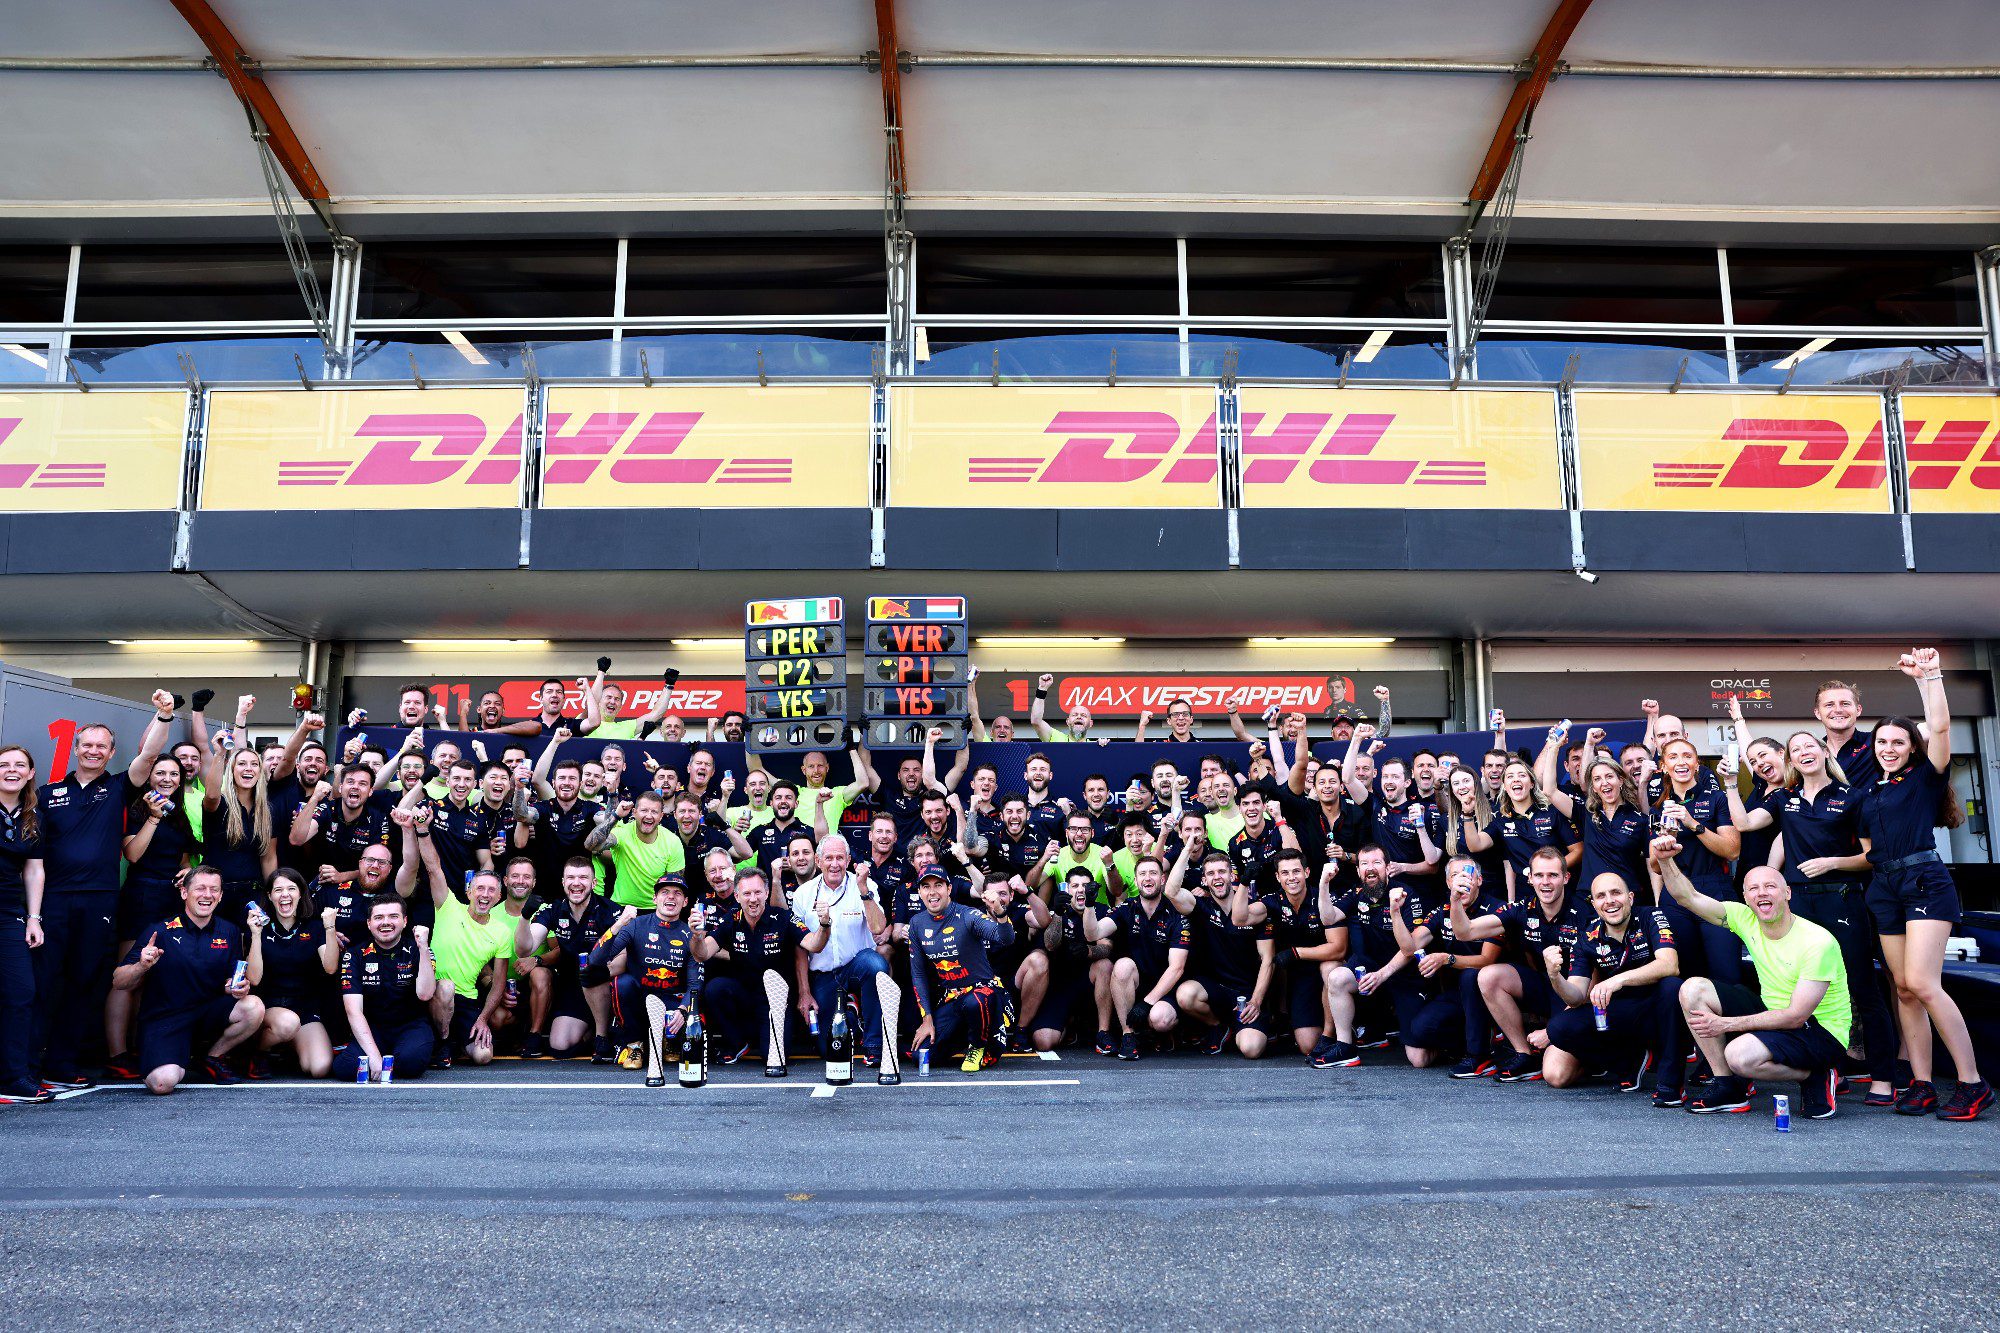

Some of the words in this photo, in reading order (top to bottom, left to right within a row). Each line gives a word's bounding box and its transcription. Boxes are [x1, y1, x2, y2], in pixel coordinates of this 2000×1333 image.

[344, 412, 724, 485] DHL
[1037, 411, 1420, 485] DHL
[1718, 418, 2000, 490] DH
[772, 627, 819, 655] PER
[891, 625, 943, 652] VER
[1005, 679, 1029, 712] 1
[1065, 686, 1138, 706] MAX
[1142, 686, 1323, 706] VERSTAPPEN
[1710, 679, 1771, 688] ORACLE
[429, 684, 470, 716] 11
[777, 690, 814, 718] YES
[895, 687, 934, 715] YES
[1716, 725, 1738, 742] 13
[843, 809, 868, 823] Bull
[644, 956, 684, 968] ORACLE
